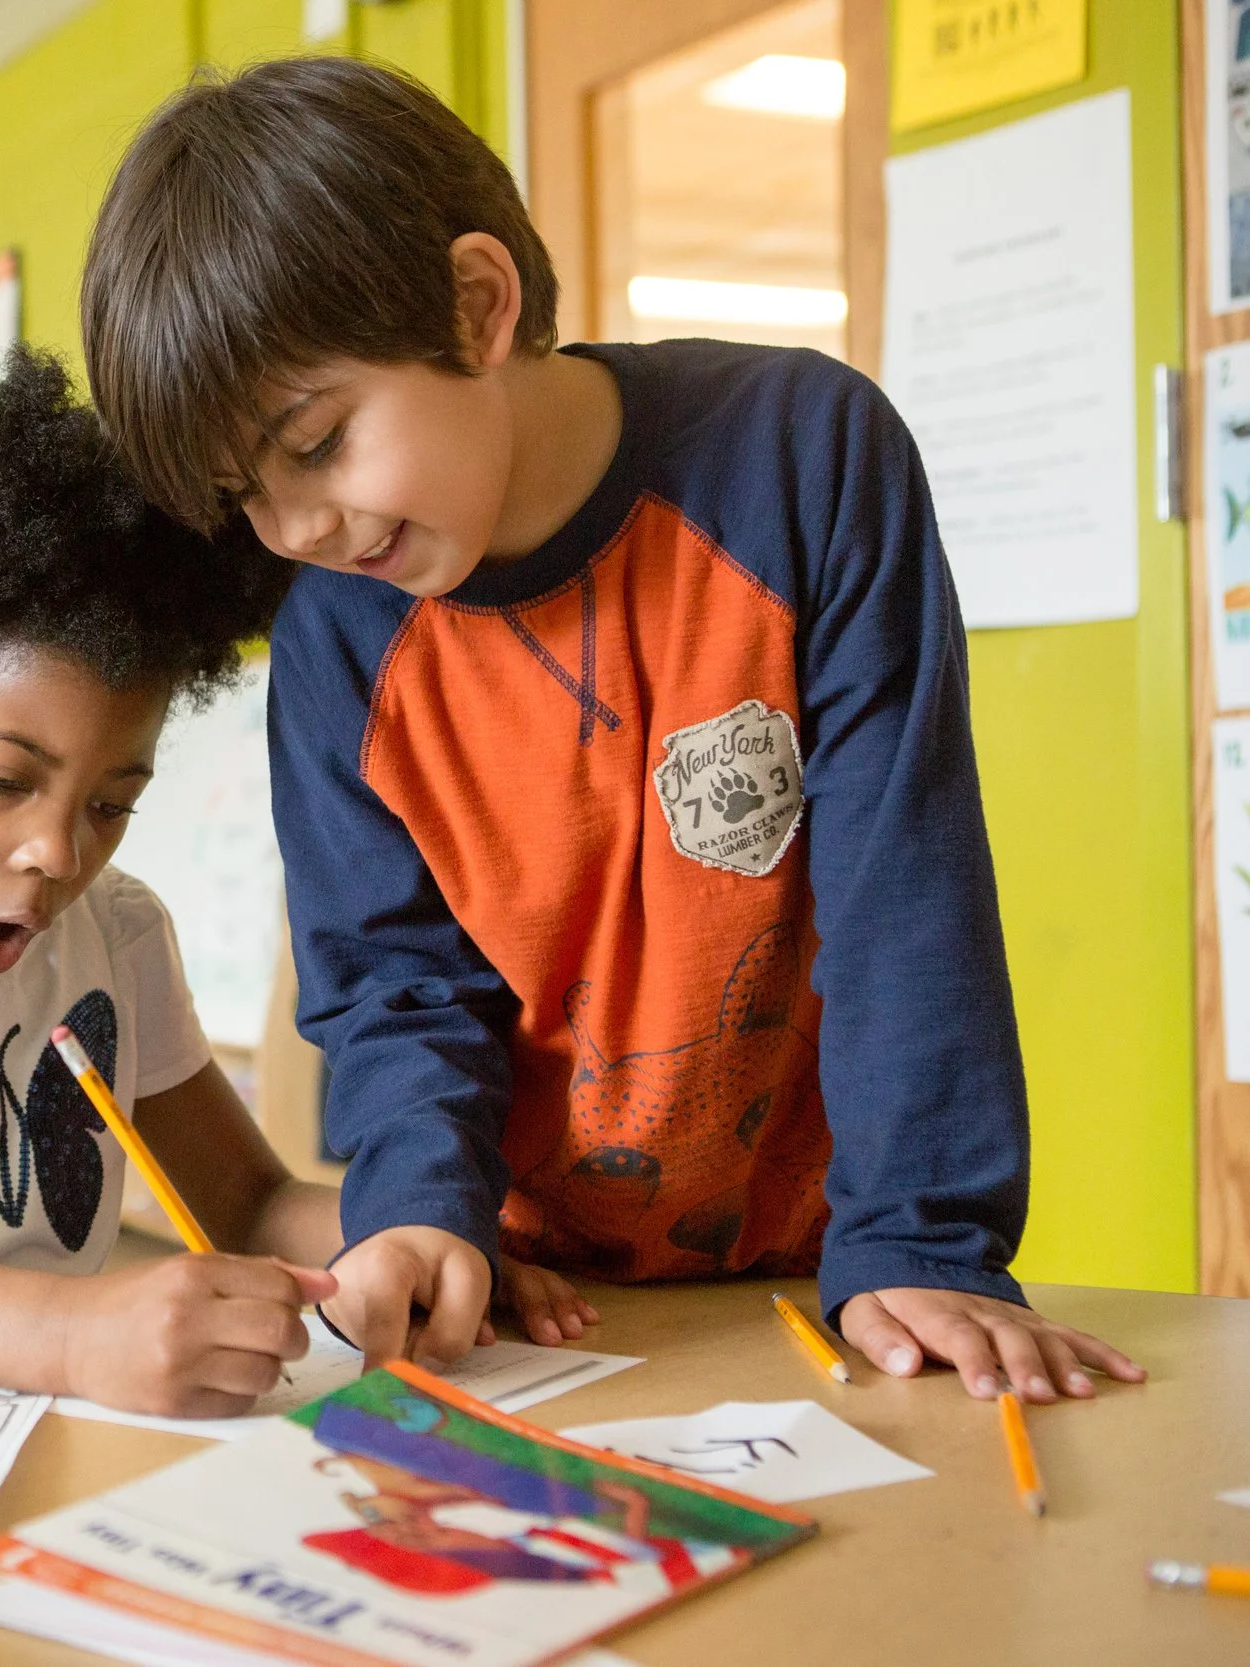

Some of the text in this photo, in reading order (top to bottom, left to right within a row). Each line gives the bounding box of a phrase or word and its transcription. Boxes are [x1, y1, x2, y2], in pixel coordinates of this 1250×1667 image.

[671, 724, 775, 805] New York
[682, 766, 789, 829] 7 3
[697, 802, 794, 851] RAZOR CLAWS
[717, 825, 780, 858] LUMBER CO.
[208, 1557, 366, 1630] Tiny
